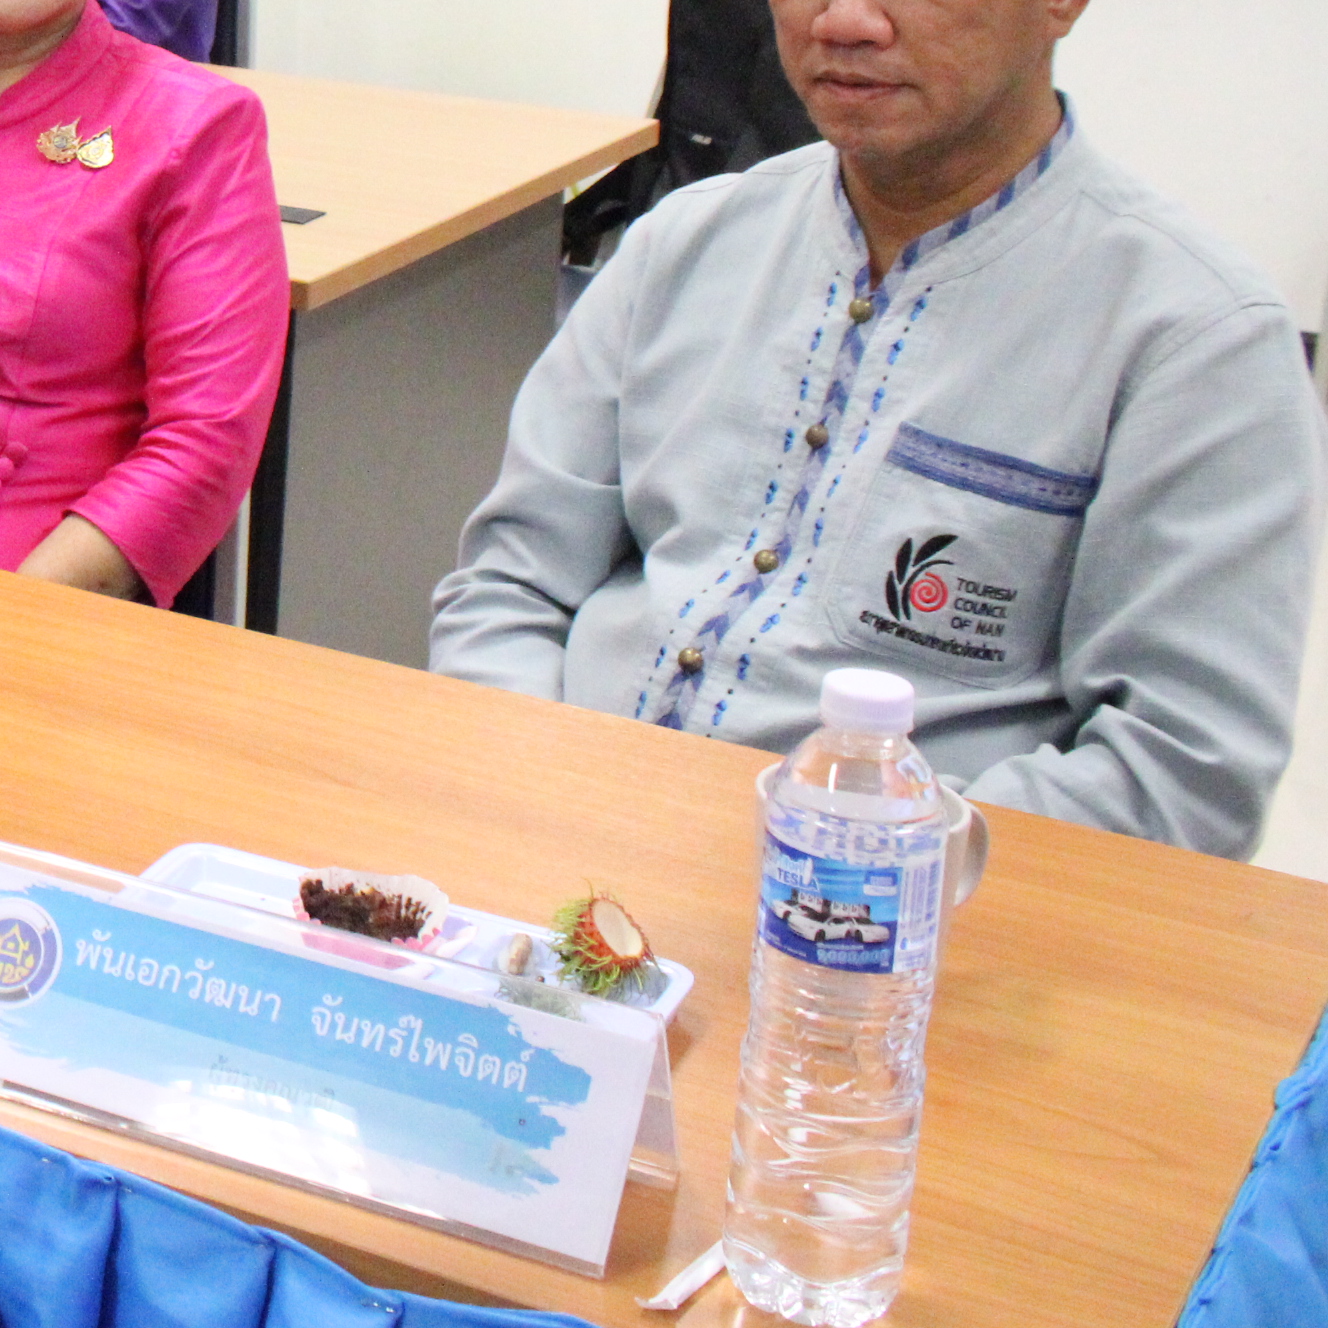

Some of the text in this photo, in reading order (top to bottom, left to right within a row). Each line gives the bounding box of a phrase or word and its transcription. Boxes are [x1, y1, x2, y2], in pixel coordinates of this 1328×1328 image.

[956, 576, 1018, 602] TOURISM
[950, 616, 1006, 638] OF NAN
[74, 928, 535, 1093] พันเอกวัฒนา จันทร์ไพจิตต์
